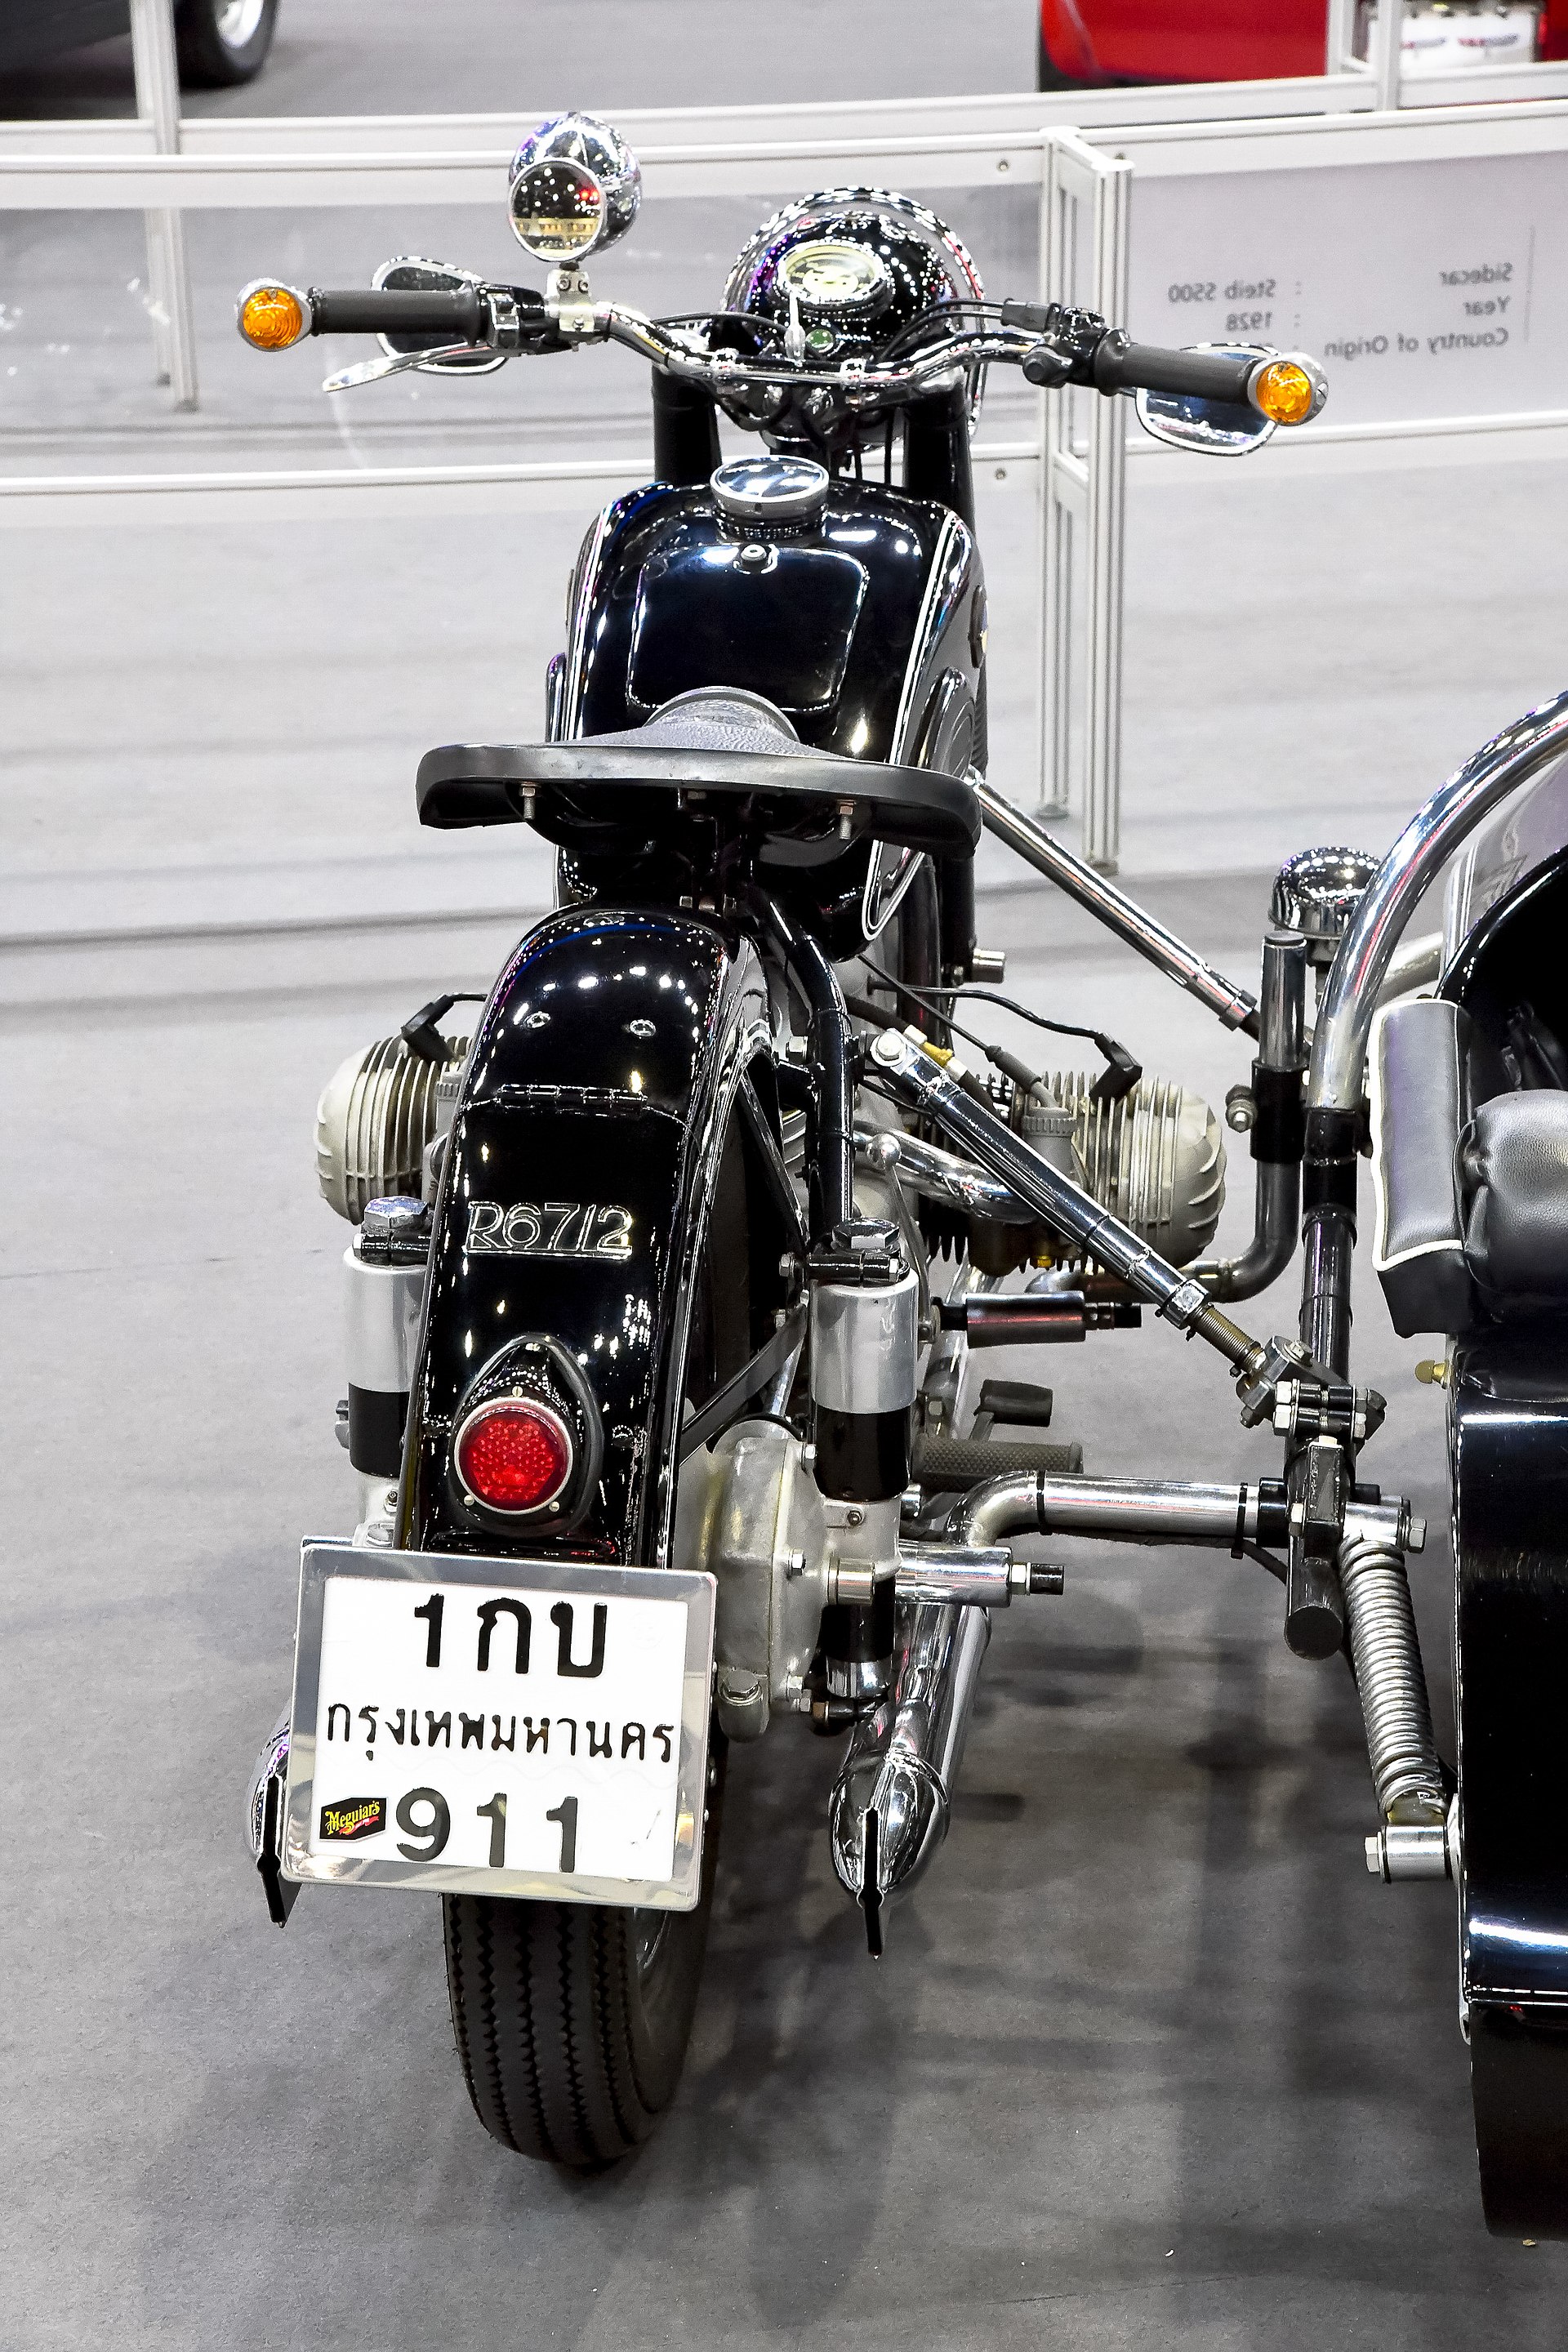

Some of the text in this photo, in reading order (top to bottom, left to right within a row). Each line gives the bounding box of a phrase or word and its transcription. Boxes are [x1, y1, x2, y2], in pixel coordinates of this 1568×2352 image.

[327, 1703, 675, 1763] กรุงเทพมหานคร
[325, 1800, 381, 1836] Meguiar's
[395, 1786, 578, 1873] 911
